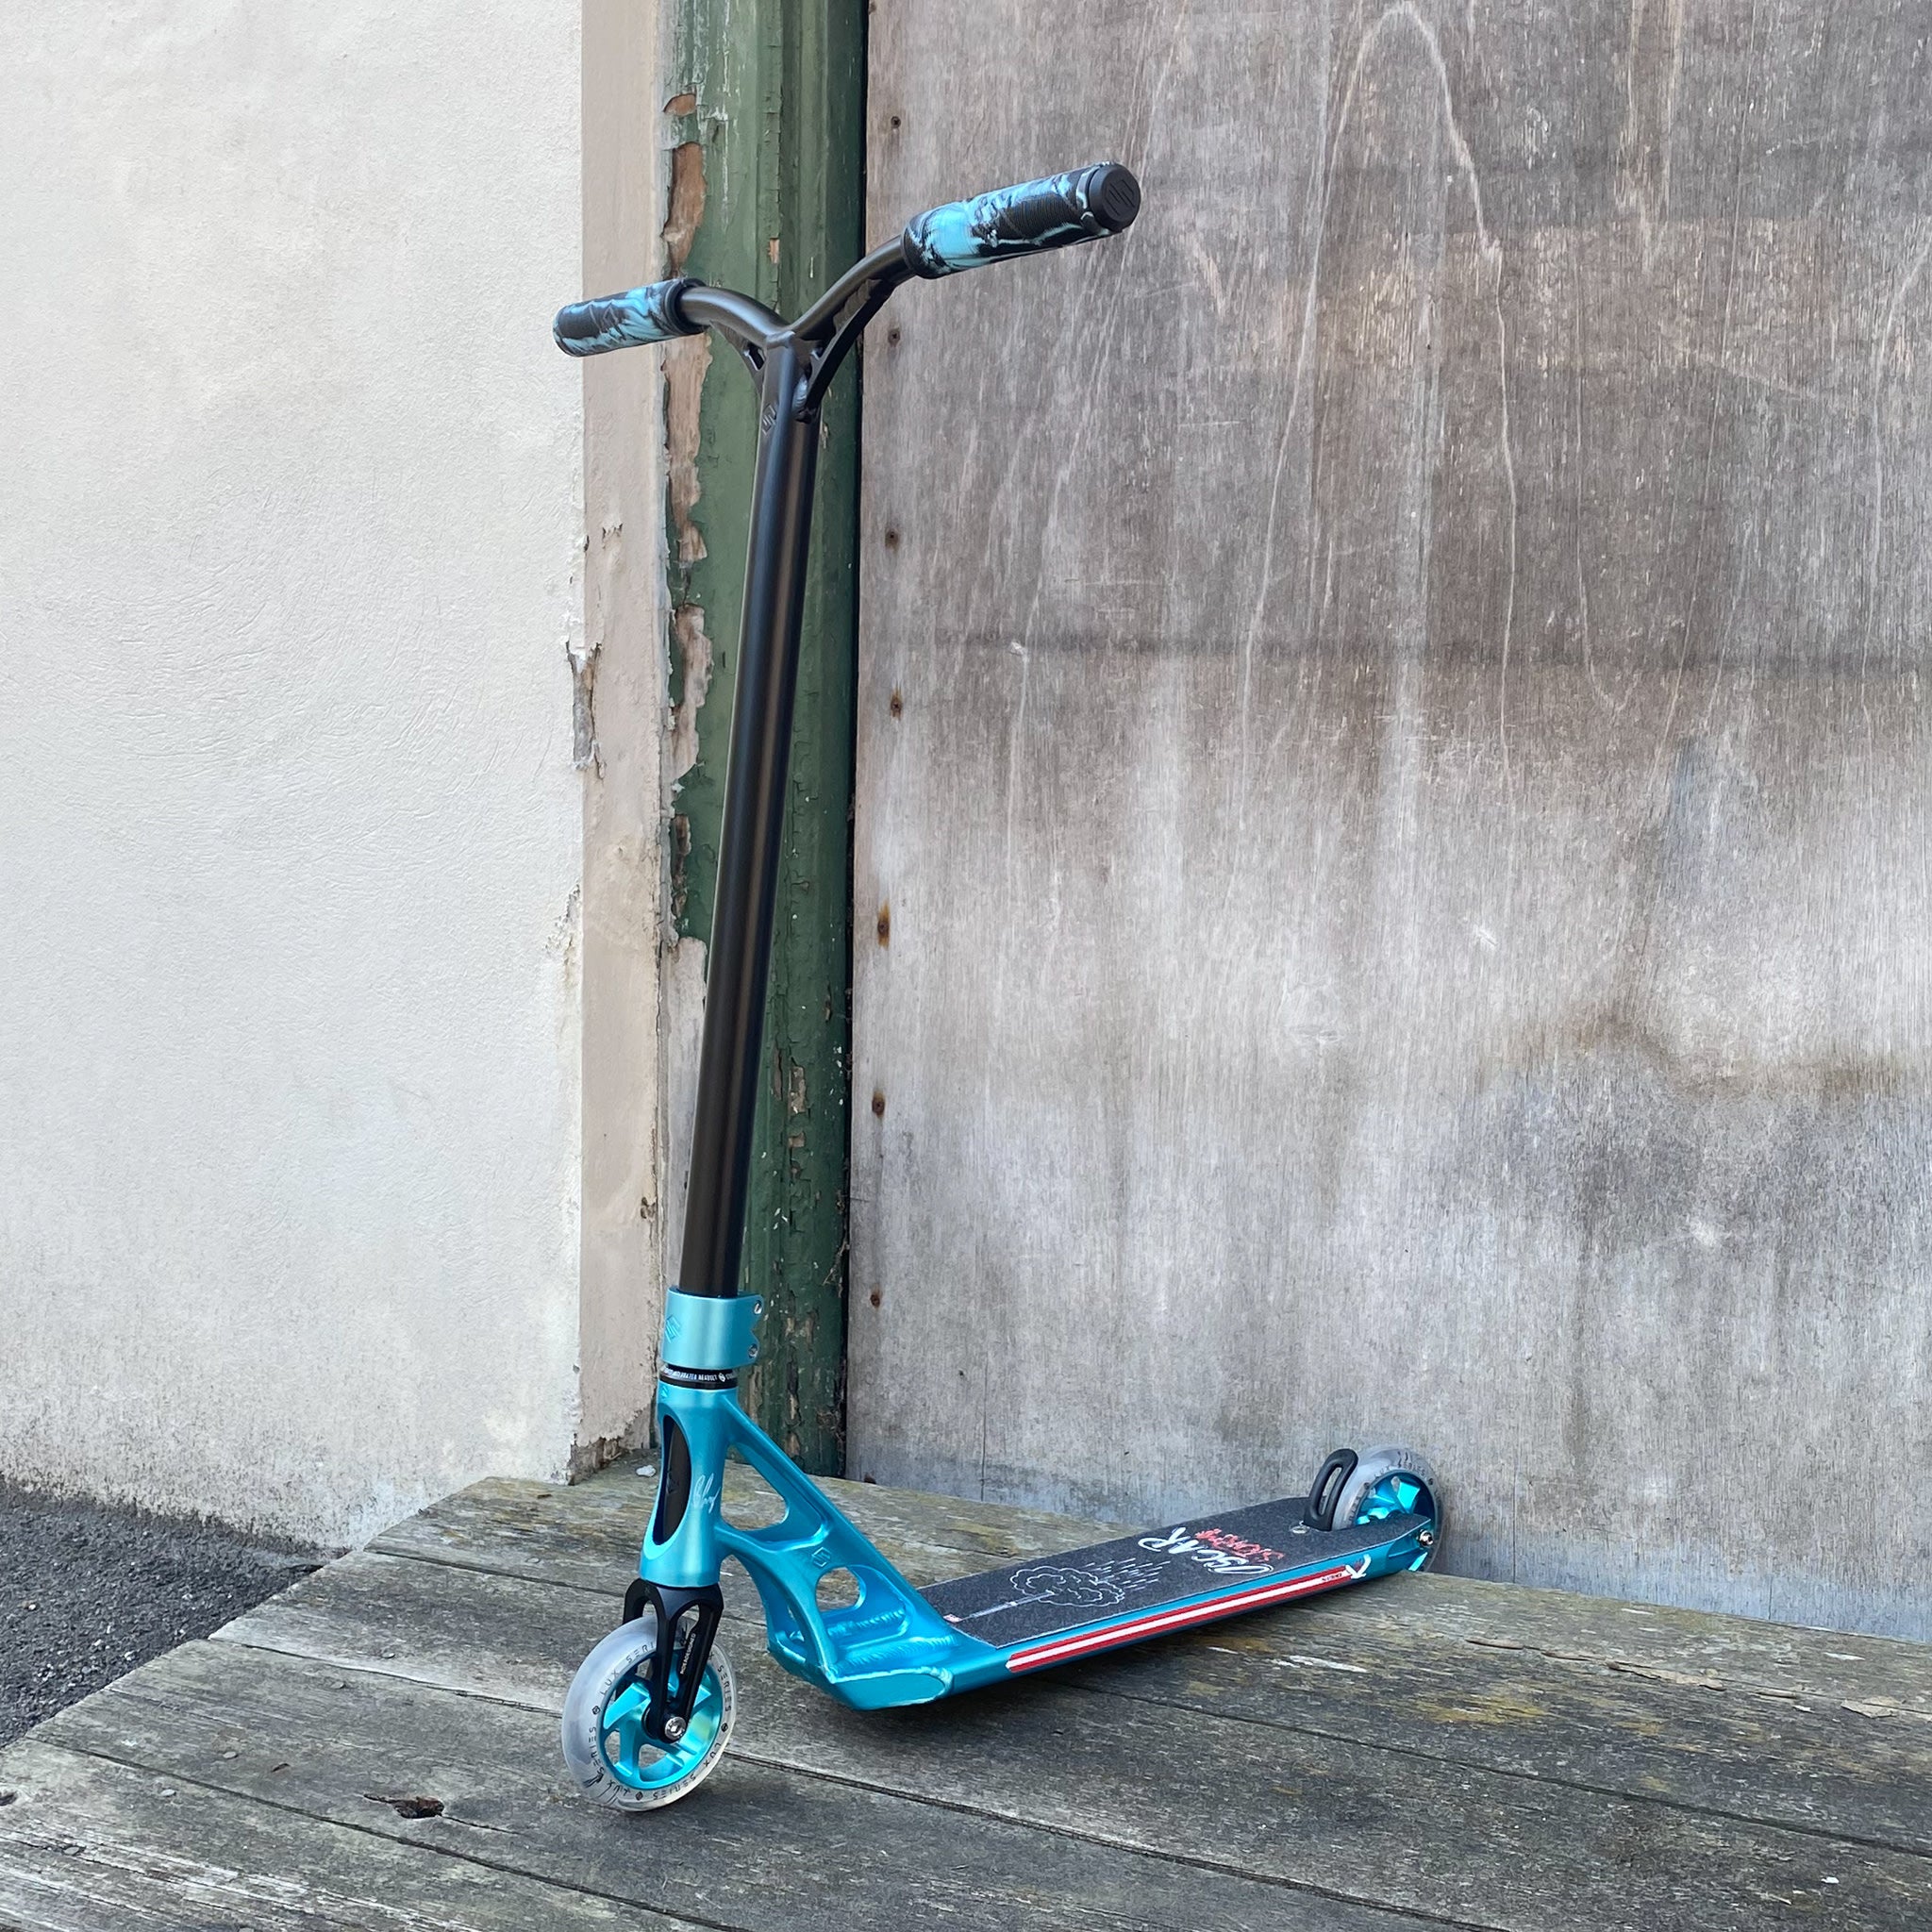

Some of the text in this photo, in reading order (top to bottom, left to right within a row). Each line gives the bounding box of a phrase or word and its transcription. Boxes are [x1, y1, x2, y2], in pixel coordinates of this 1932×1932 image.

[1138, 1526, 1274, 1574] OSCAR
[601, 1670, 622, 1696] LUX
[716, 1664, 732, 1713] SERIES
[589, 1726, 606, 1775] SERIES
[653, 1743, 722, 1801] LUX SERIES
